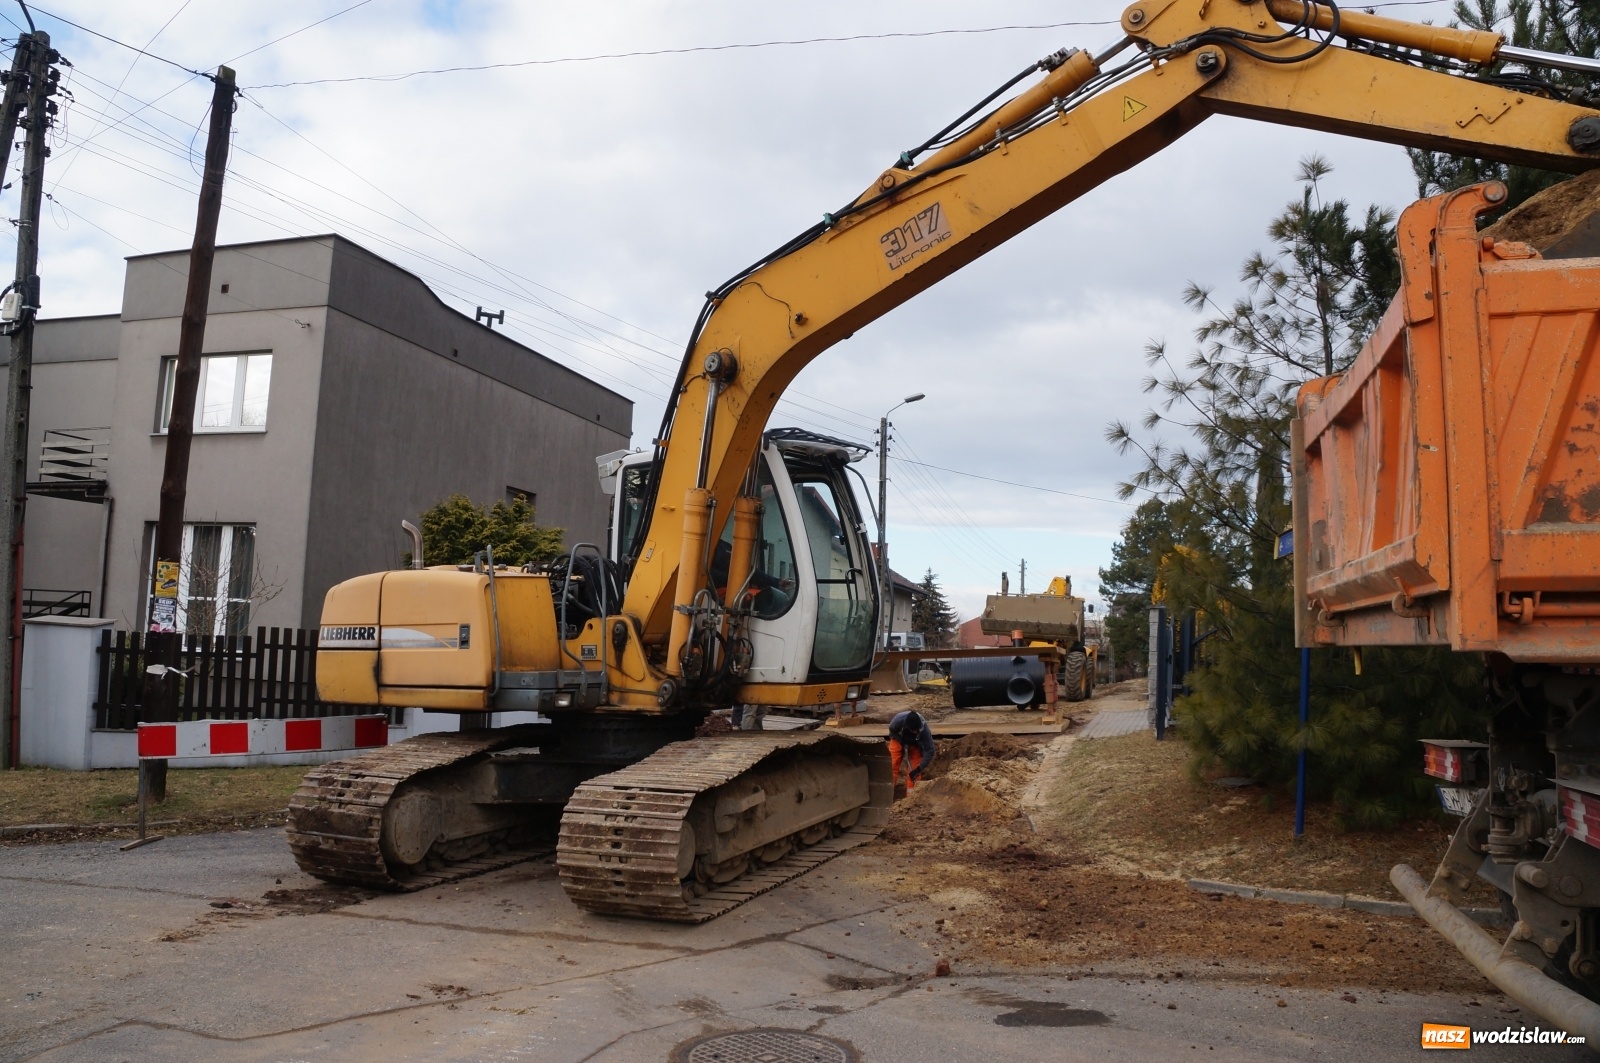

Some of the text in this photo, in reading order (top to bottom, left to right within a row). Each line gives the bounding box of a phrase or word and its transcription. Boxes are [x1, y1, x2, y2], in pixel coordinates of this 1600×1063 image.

[880, 201, 940, 258] 317
[888, 231, 952, 271] Litronic
[320, 626, 376, 641] LIEBHERR
